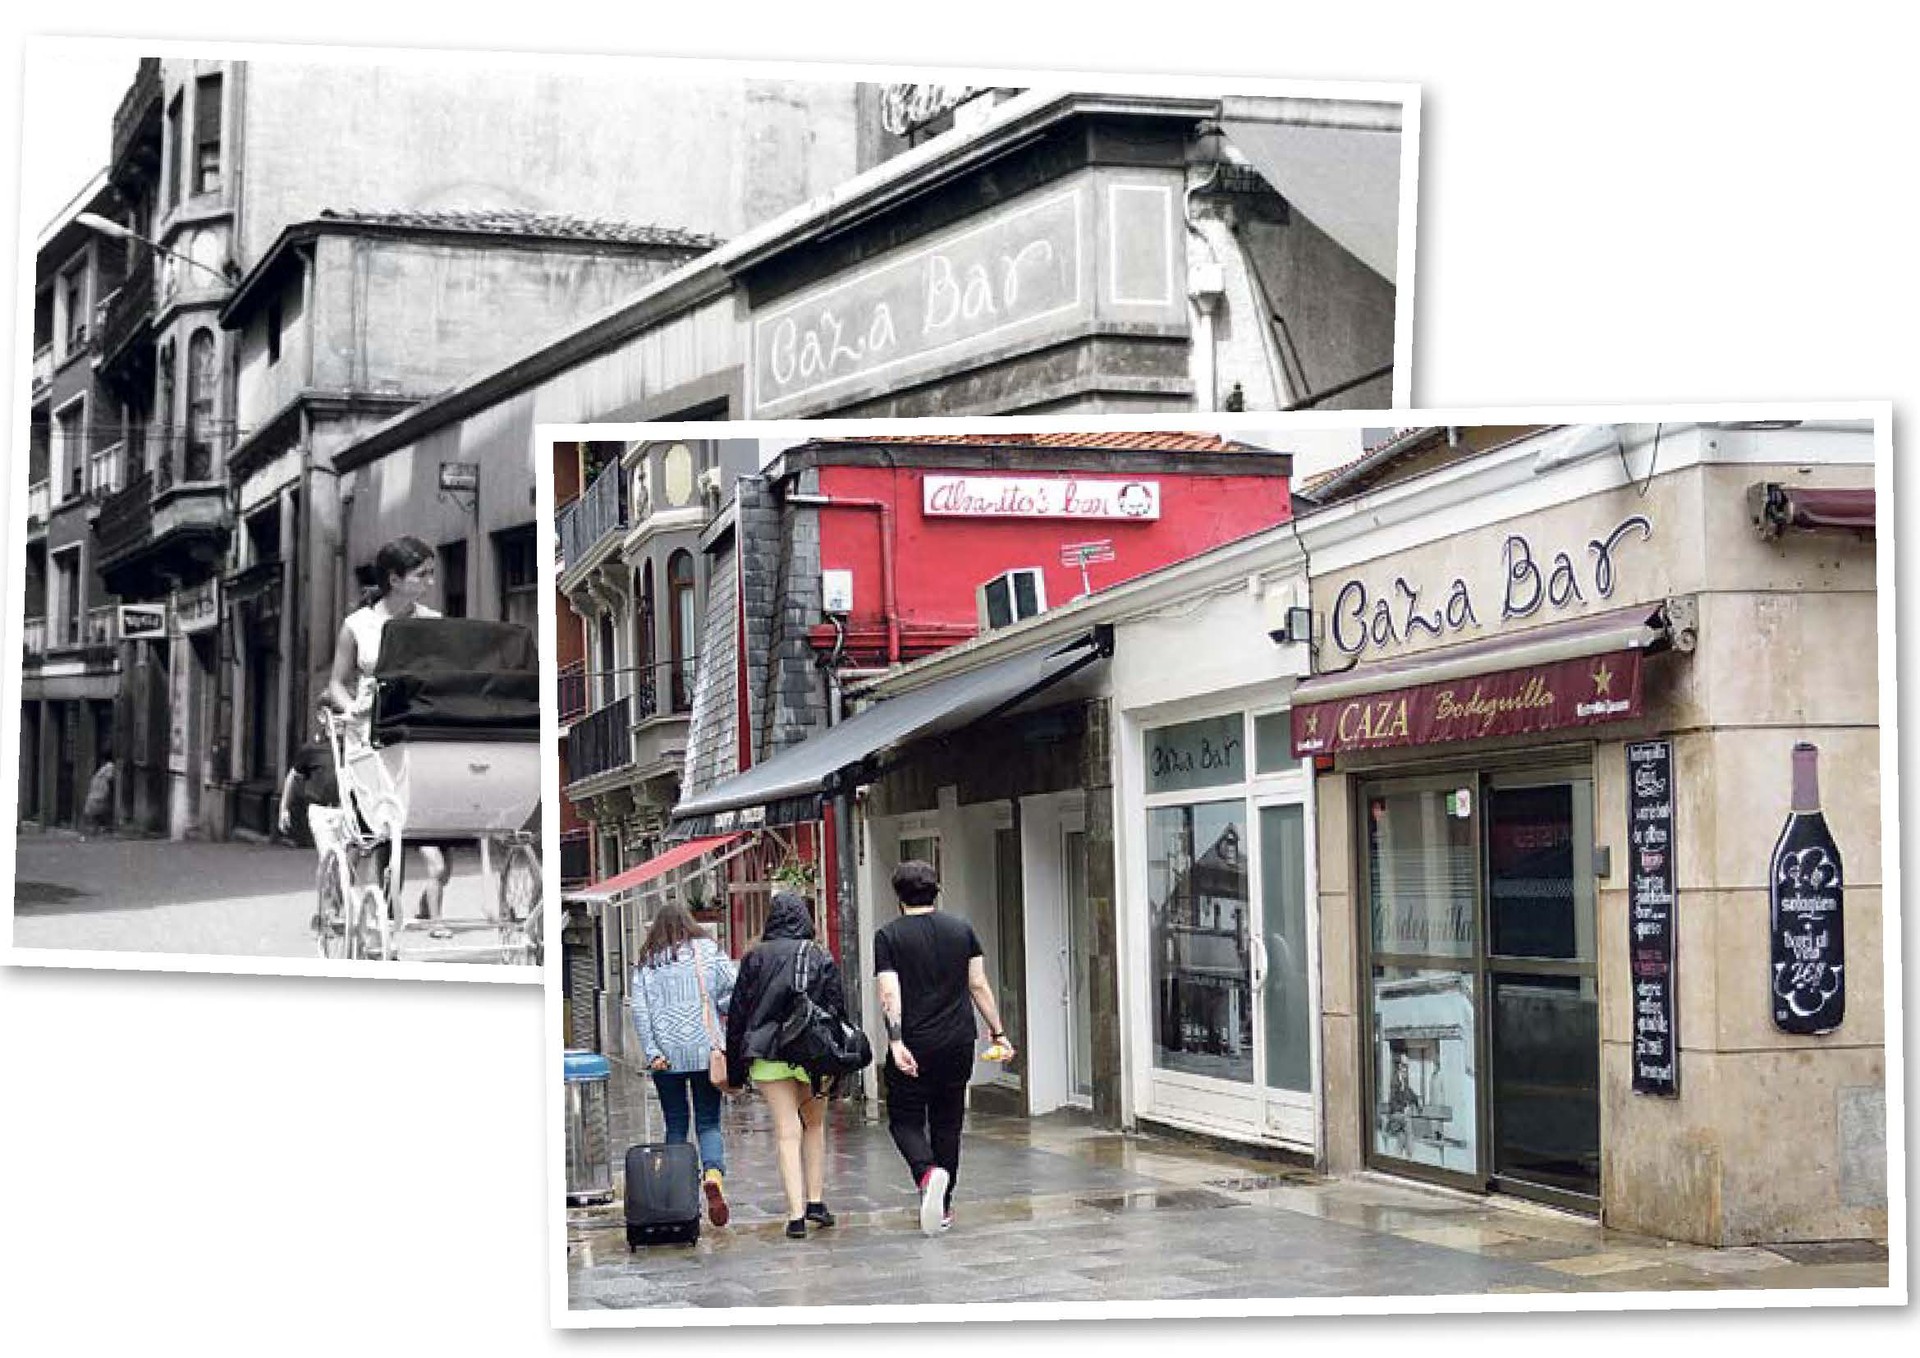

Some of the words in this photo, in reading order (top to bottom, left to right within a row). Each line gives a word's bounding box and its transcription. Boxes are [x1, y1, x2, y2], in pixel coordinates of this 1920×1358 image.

[770, 302, 897, 386] Caza
[921, 239, 1055, 337] Bar
[1332, 576, 1481, 655] Caza
[1501, 513, 1653, 620] Bar
[1337, 696, 1409, 743] CAZA
